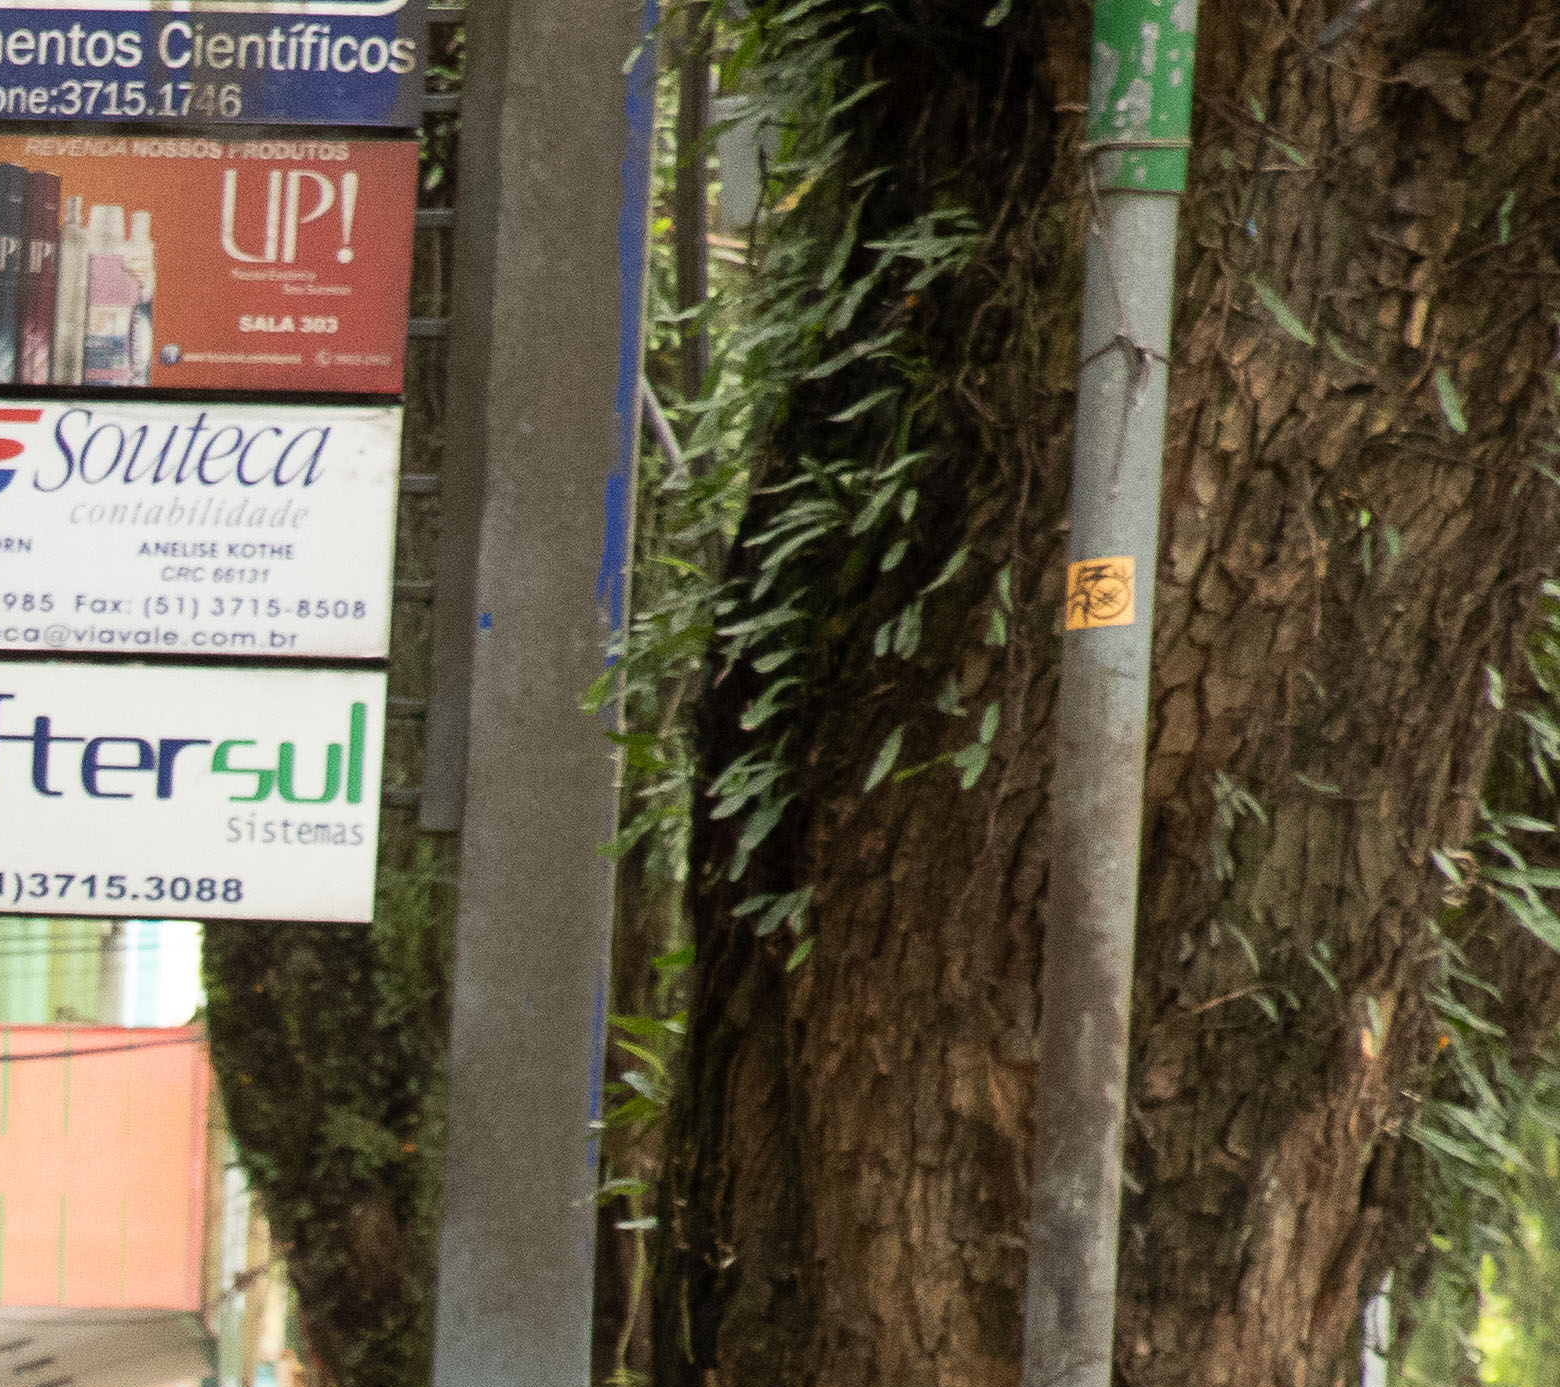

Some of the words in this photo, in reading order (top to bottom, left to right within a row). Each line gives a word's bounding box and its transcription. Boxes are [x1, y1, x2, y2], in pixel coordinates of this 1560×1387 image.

[158, 19, 417, 75] Científicos
[132, 138, 222, 160] NOSSOS
[226, 140, 350, 162] PRODUTOS
[221, 168, 360, 264] UP!
[238, 314, 296, 333] SALA
[33, 407, 333, 493] Souteca
[68, 495, 310, 529] contabilidade
[137, 541, 219, 559] ANELISE
[226, 543, 296, 560] KOTHE
[160, 565, 205, 583] CRC
[73, 594, 132, 615] Fax:
[143, 596, 200, 620] (51)
[210, 596, 368, 620] 3715-8508
[226, 815, 365, 846] Sistemas
